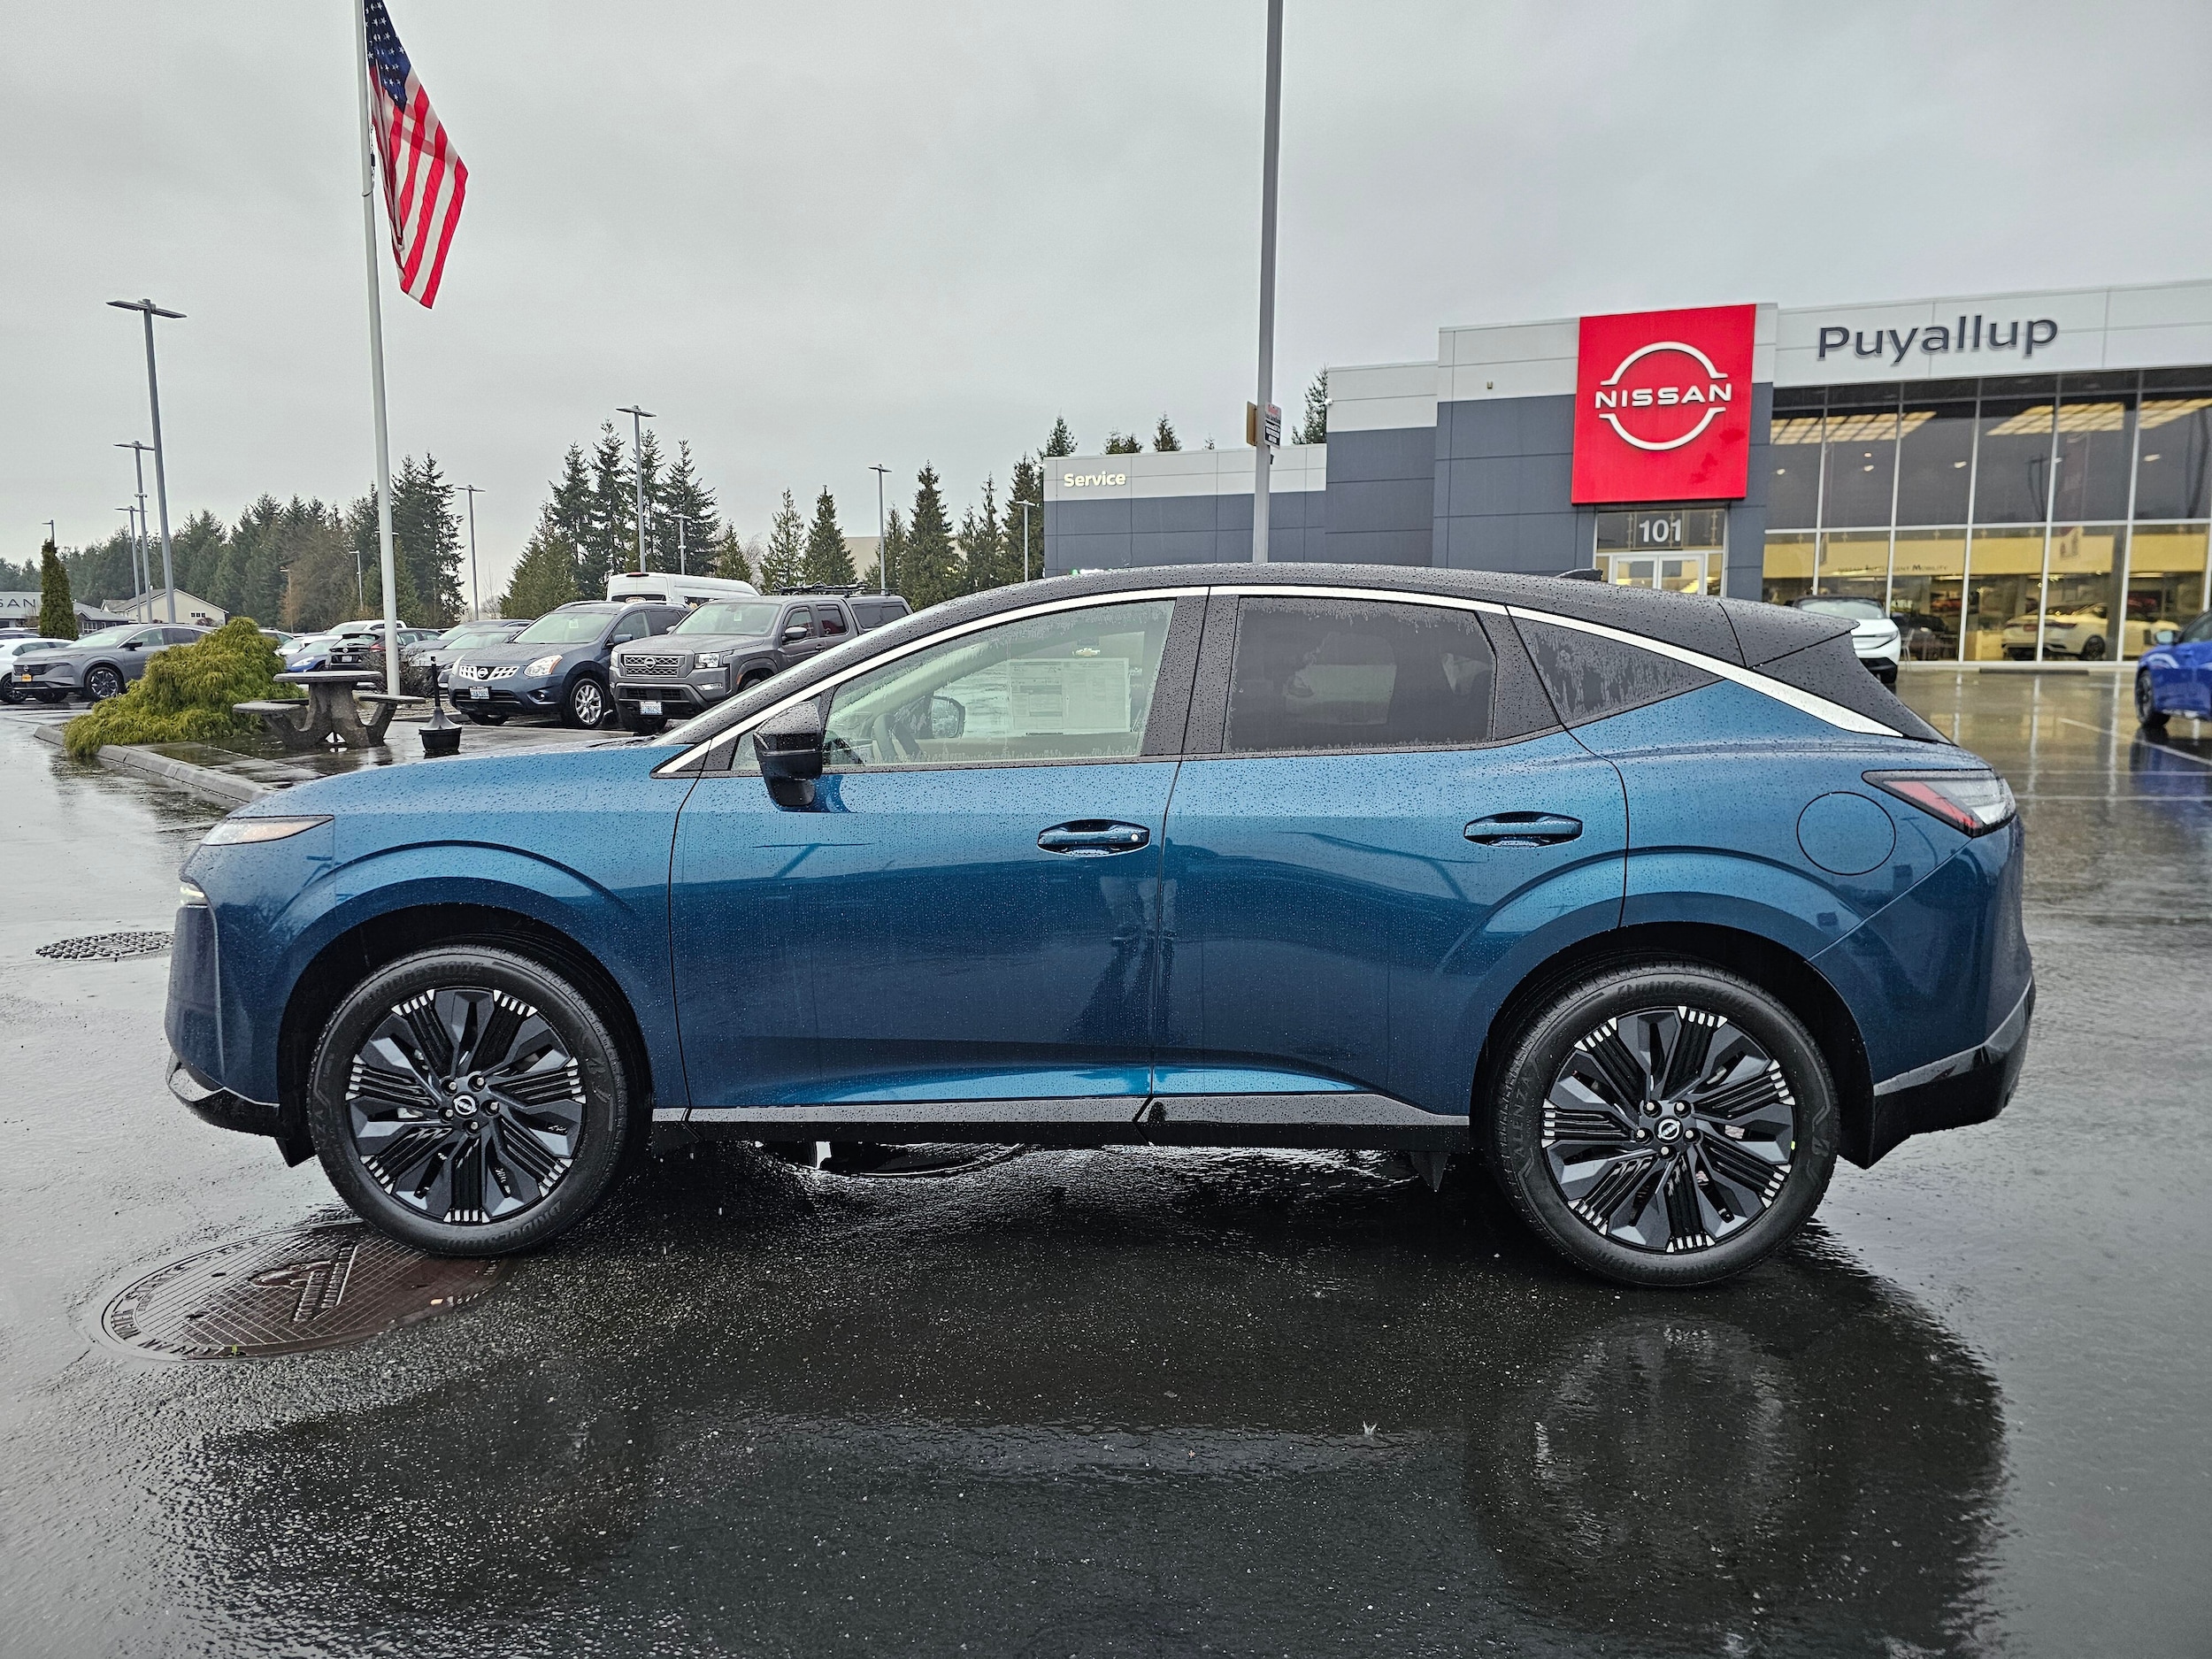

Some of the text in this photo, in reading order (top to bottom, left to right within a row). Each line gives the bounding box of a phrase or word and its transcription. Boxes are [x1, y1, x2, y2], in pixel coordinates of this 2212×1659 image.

[1817, 314, 2058, 365] Puyallup
[1594, 383, 1732, 409] NISSAN
[1064, 471, 1126, 488] Service
[1639, 518, 1682, 542] 101
[0, 598, 35, 608] AN
[1512, 1076, 1533, 1157] ALENZA
